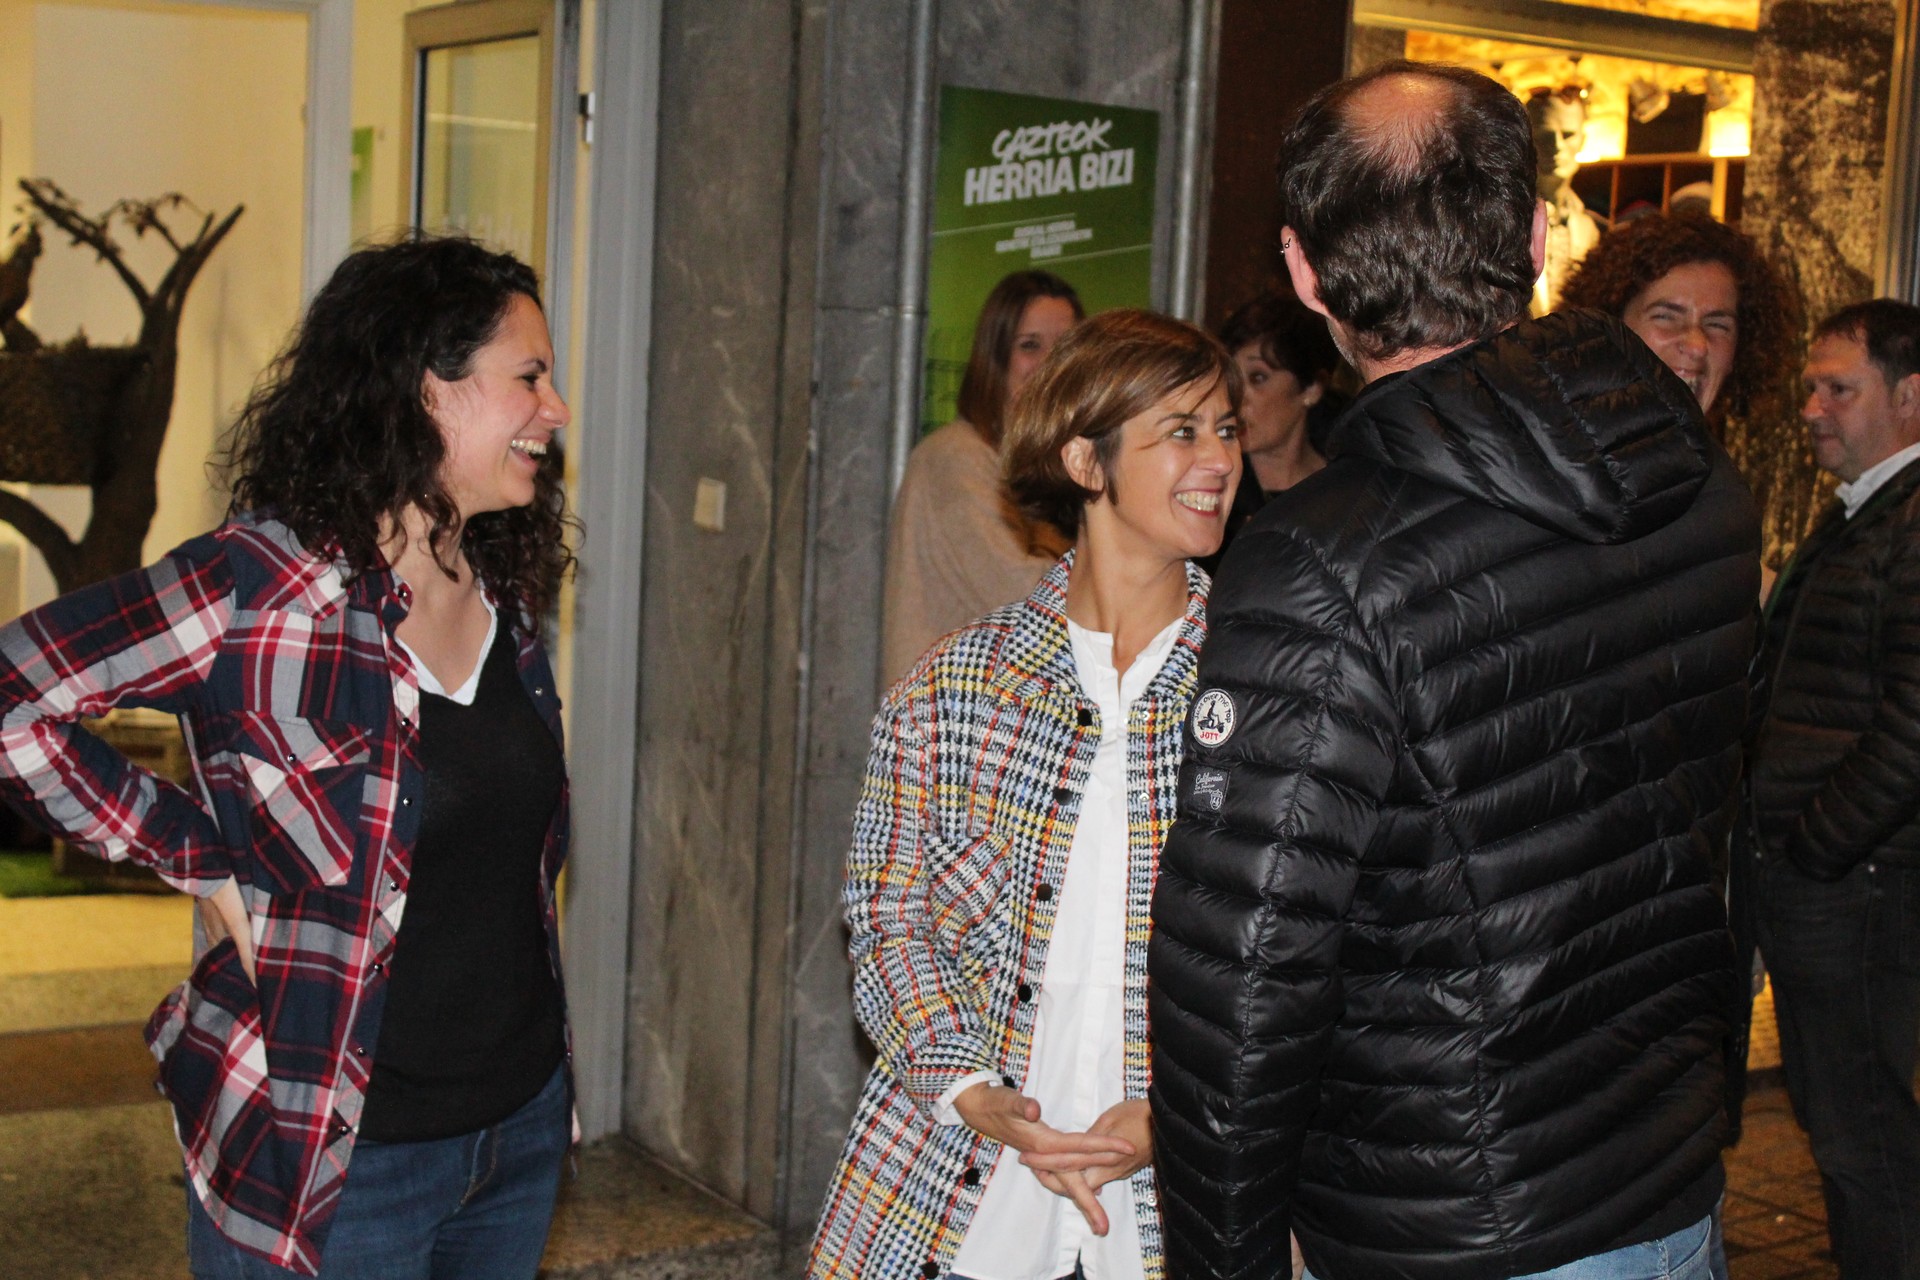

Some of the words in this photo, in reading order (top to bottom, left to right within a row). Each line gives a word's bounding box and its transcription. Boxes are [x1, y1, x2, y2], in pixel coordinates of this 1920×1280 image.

[964, 156, 1076, 206] HERRIA
[1079, 148, 1135, 191] BIZI
[1200, 731, 1219, 740] JOTT
[1195, 772, 1223, 784] California
